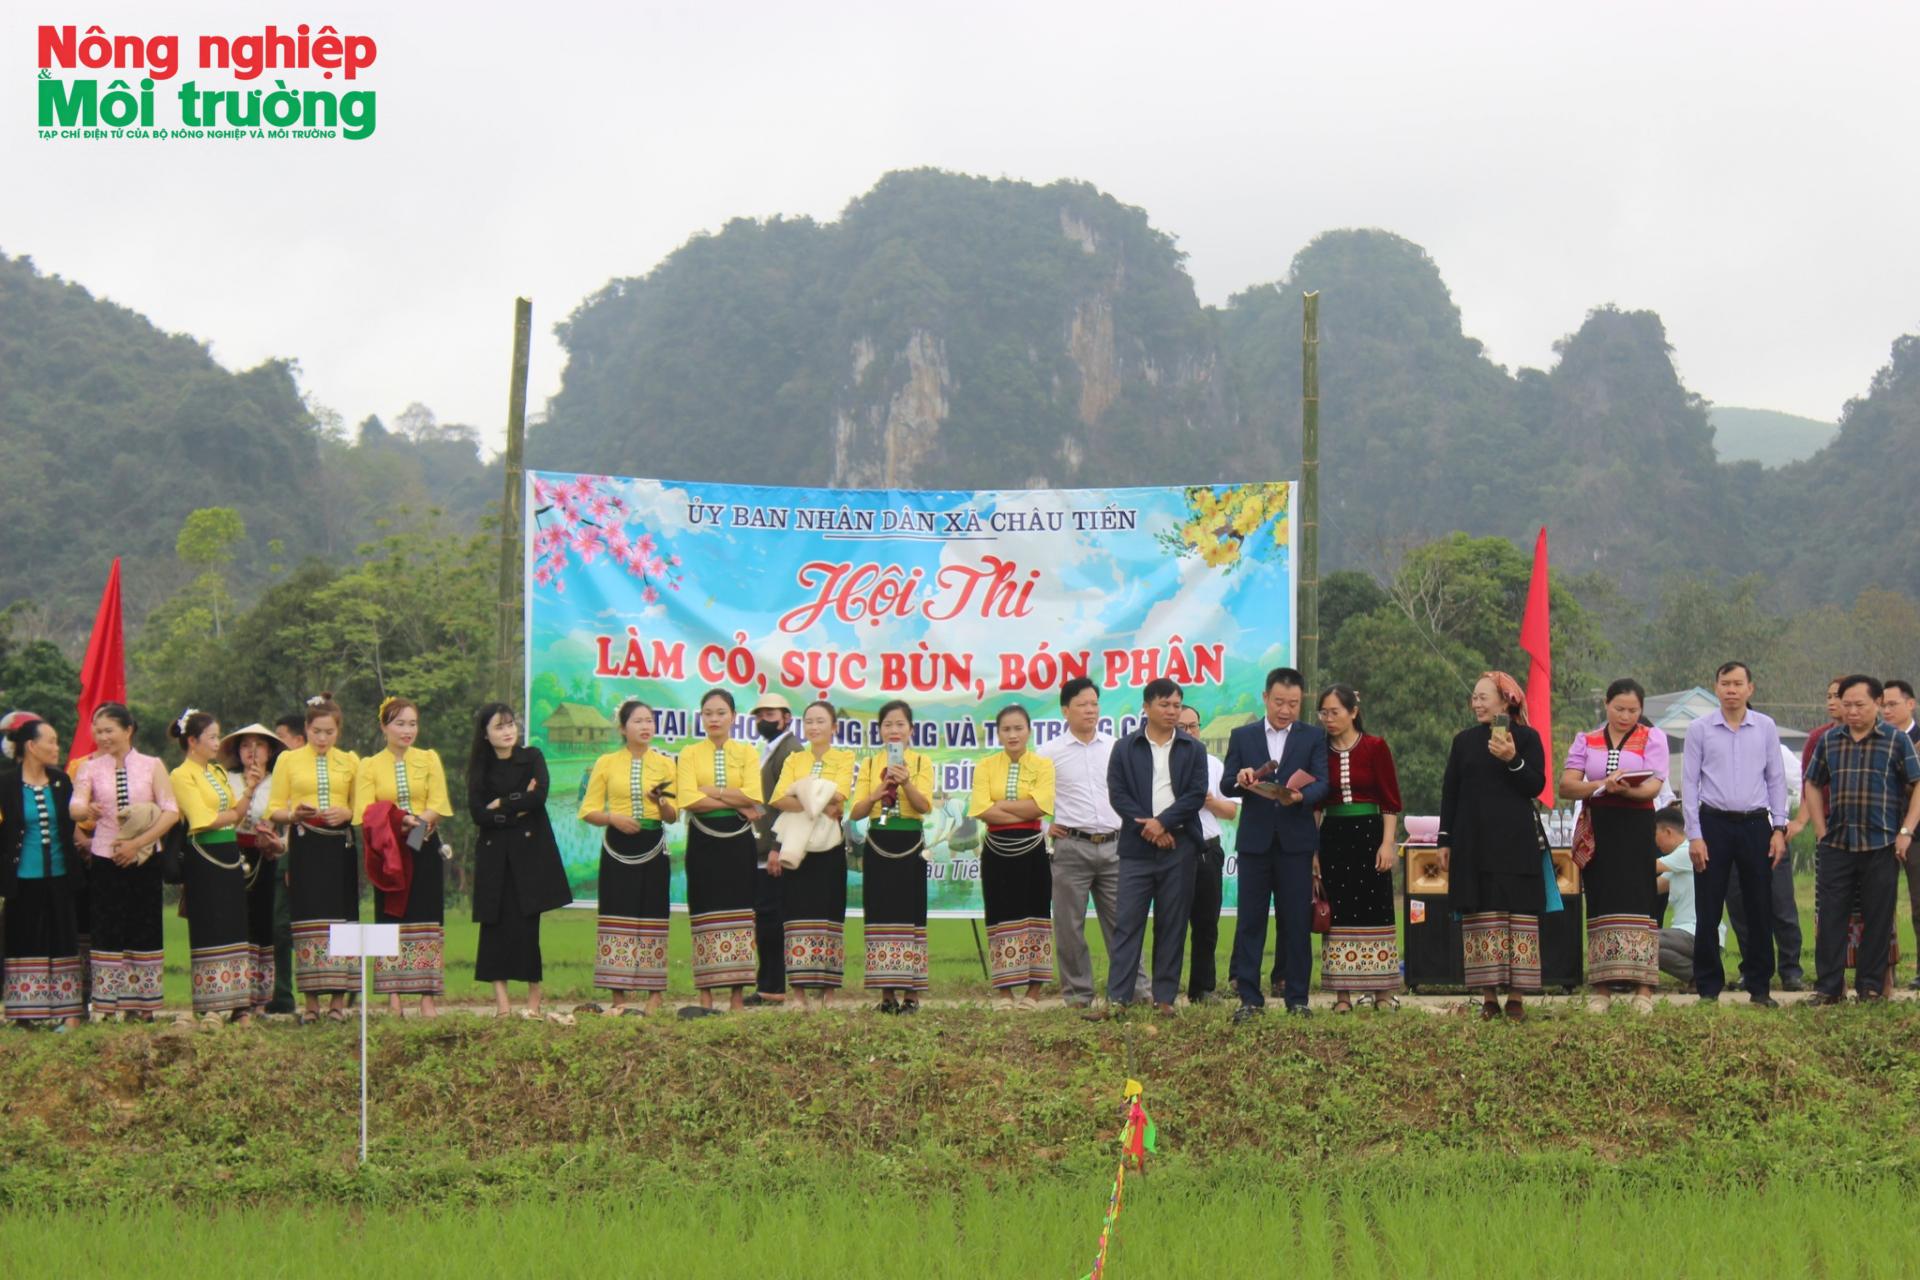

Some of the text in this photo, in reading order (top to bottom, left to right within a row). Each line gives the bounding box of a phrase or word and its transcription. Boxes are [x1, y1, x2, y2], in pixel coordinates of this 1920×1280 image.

[688, 497, 1137, 532] ỦY BAN NHÂN DÂN XÃ CHÂU TIẾN
[778, 555, 1041, 633] Hội Thi
[595, 627, 1225, 700] LÀM CỎ, SỤC BÙN, BÓN PHÂN
[654, 710, 686, 741] TẠI
[869, 721, 937, 747] ĐNG
[945, 716, 977, 747] VÀ
